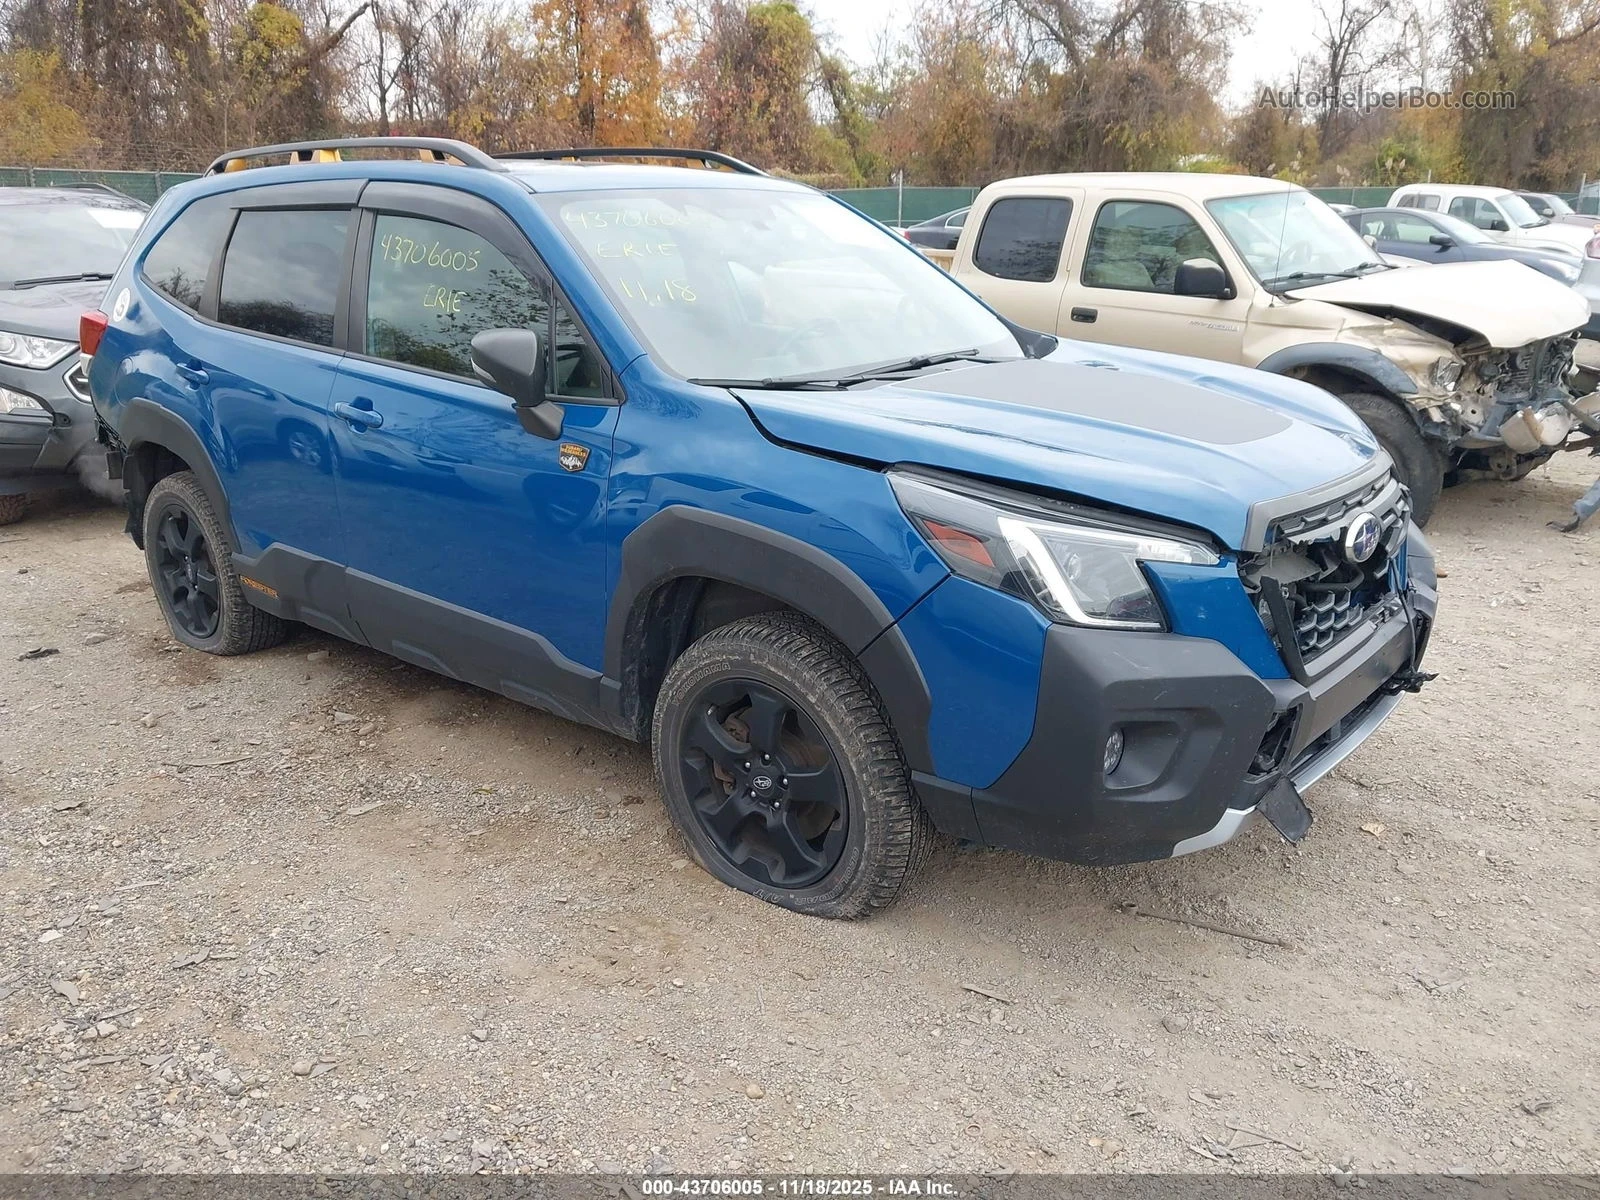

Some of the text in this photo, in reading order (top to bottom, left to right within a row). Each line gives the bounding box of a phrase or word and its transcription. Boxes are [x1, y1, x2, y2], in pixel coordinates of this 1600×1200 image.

[381, 234, 481, 272] 43706005
[597, 240, 678, 258] ERIE
[423, 284, 468, 312] ERIE
